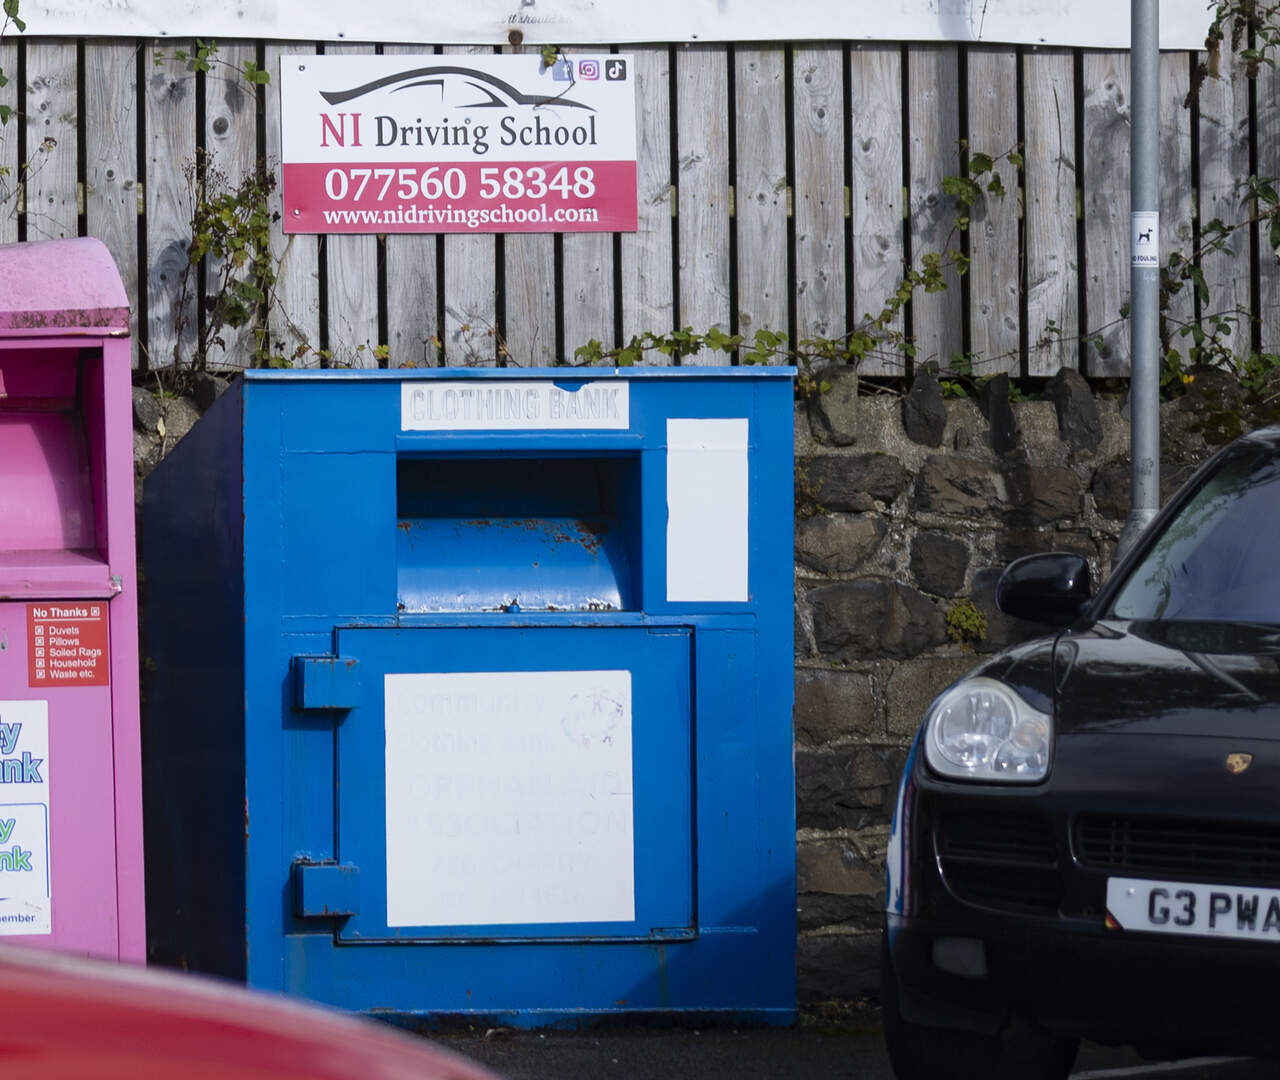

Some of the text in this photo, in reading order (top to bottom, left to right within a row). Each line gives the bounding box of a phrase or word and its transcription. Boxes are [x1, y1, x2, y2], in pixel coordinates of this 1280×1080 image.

[319, 112, 598, 155] NI Driving School
[324, 167, 596, 201] 077560 58348
[323, 202, 599, 228] www.nidrivingschool.com
[410, 388, 619, 420] CLOTHING BANK
[33, 608, 88, 617] No Thanks
[49, 626, 79, 635] Duvets
[49, 637, 79, 646] Pillows
[50, 648, 101, 657] Soiled Rags
[50, 658, 96, 667] Household
[50, 670, 95, 678] Waste etc.
[1148, 888, 1197, 926] G3
